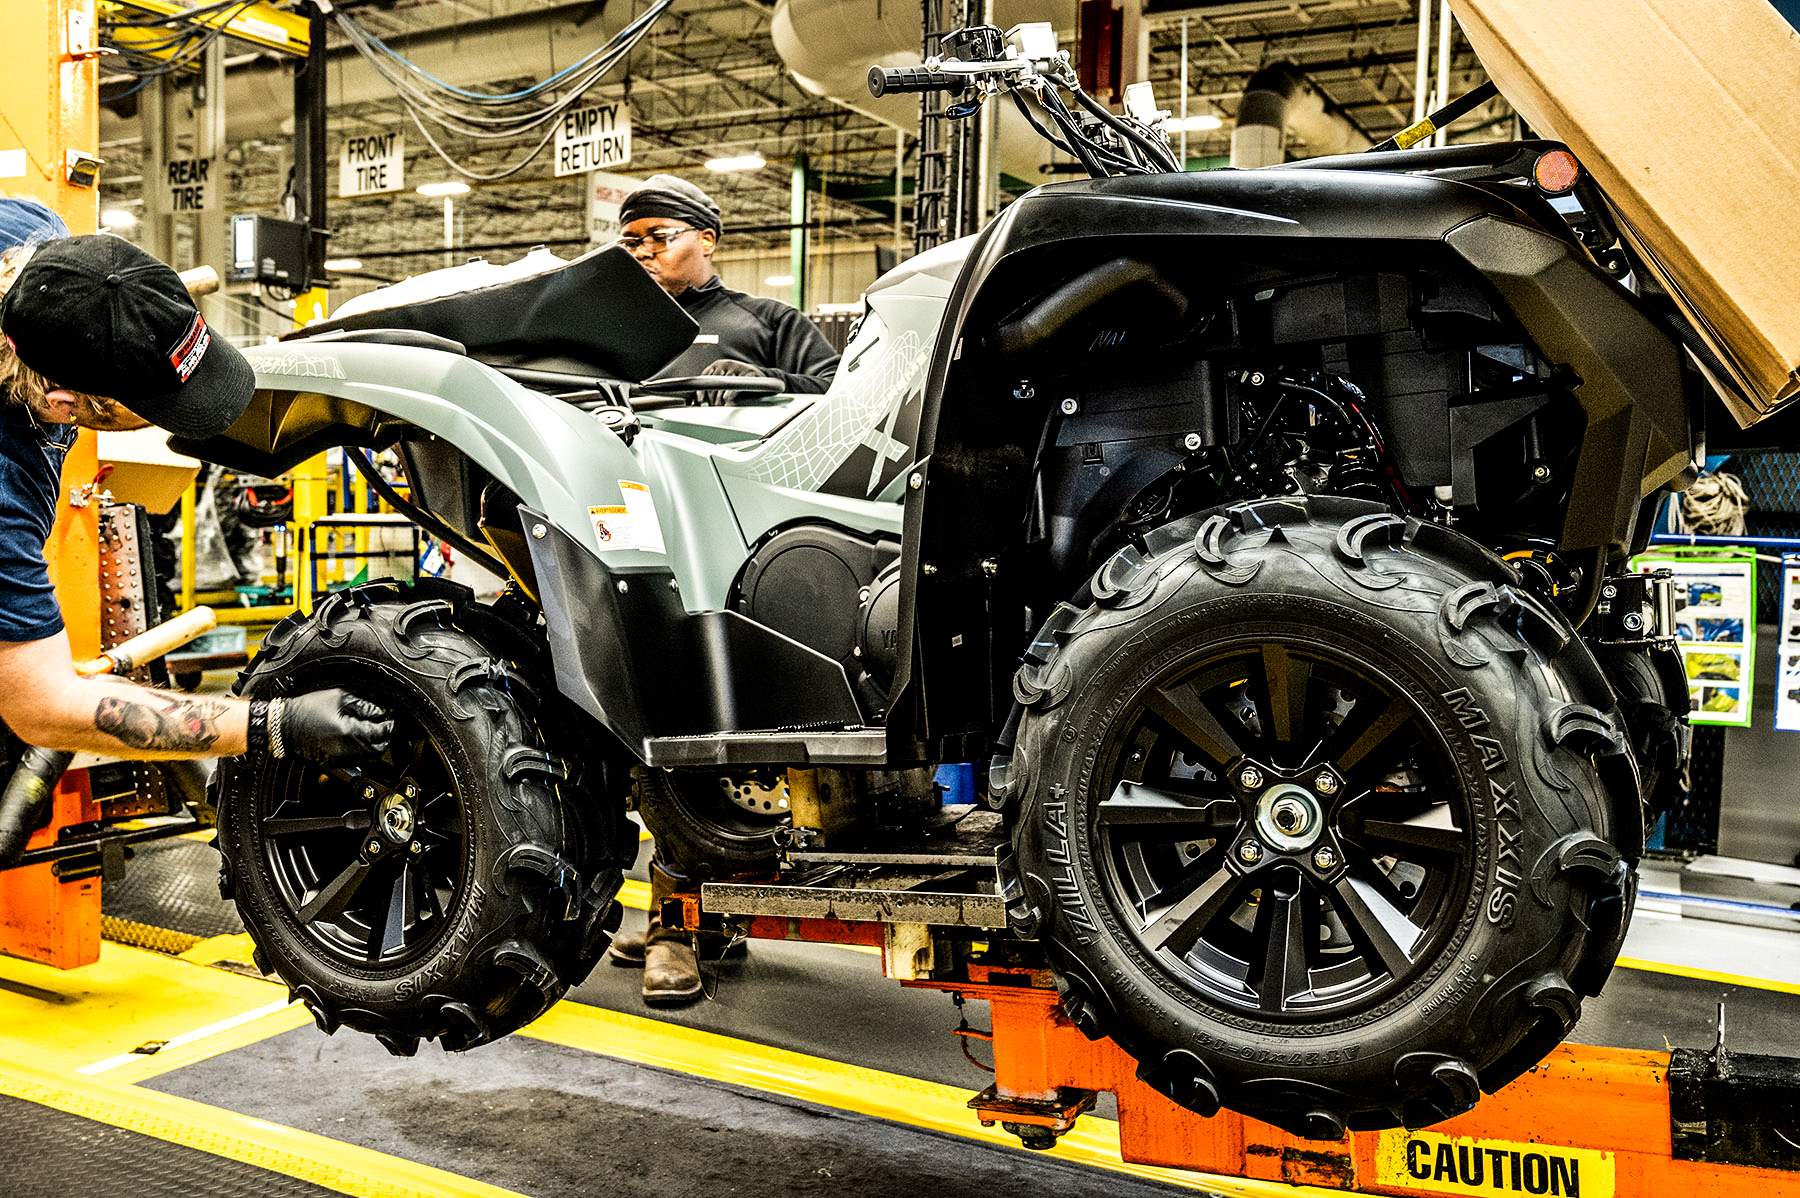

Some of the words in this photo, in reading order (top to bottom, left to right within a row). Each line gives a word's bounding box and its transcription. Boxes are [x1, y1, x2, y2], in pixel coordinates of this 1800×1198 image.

[565, 104, 618, 140] EMPTY
[348, 132, 396, 163] FRONT
[561, 135, 624, 171] RETURN
[168, 158, 209, 184] REAR
[357, 164, 387, 191] TIRE
[172, 186, 203, 210] TIRE
[1442, 686, 1525, 929] MAXXIS
[394, 879, 487, 1002] MAXXIS
[1454, 964, 1472, 985] PLY
[1422, 984, 1455, 1015] RATING
[1447, 975, 1478, 1007] NYLON
[1406, 1139, 1581, 1198] CAUTION
